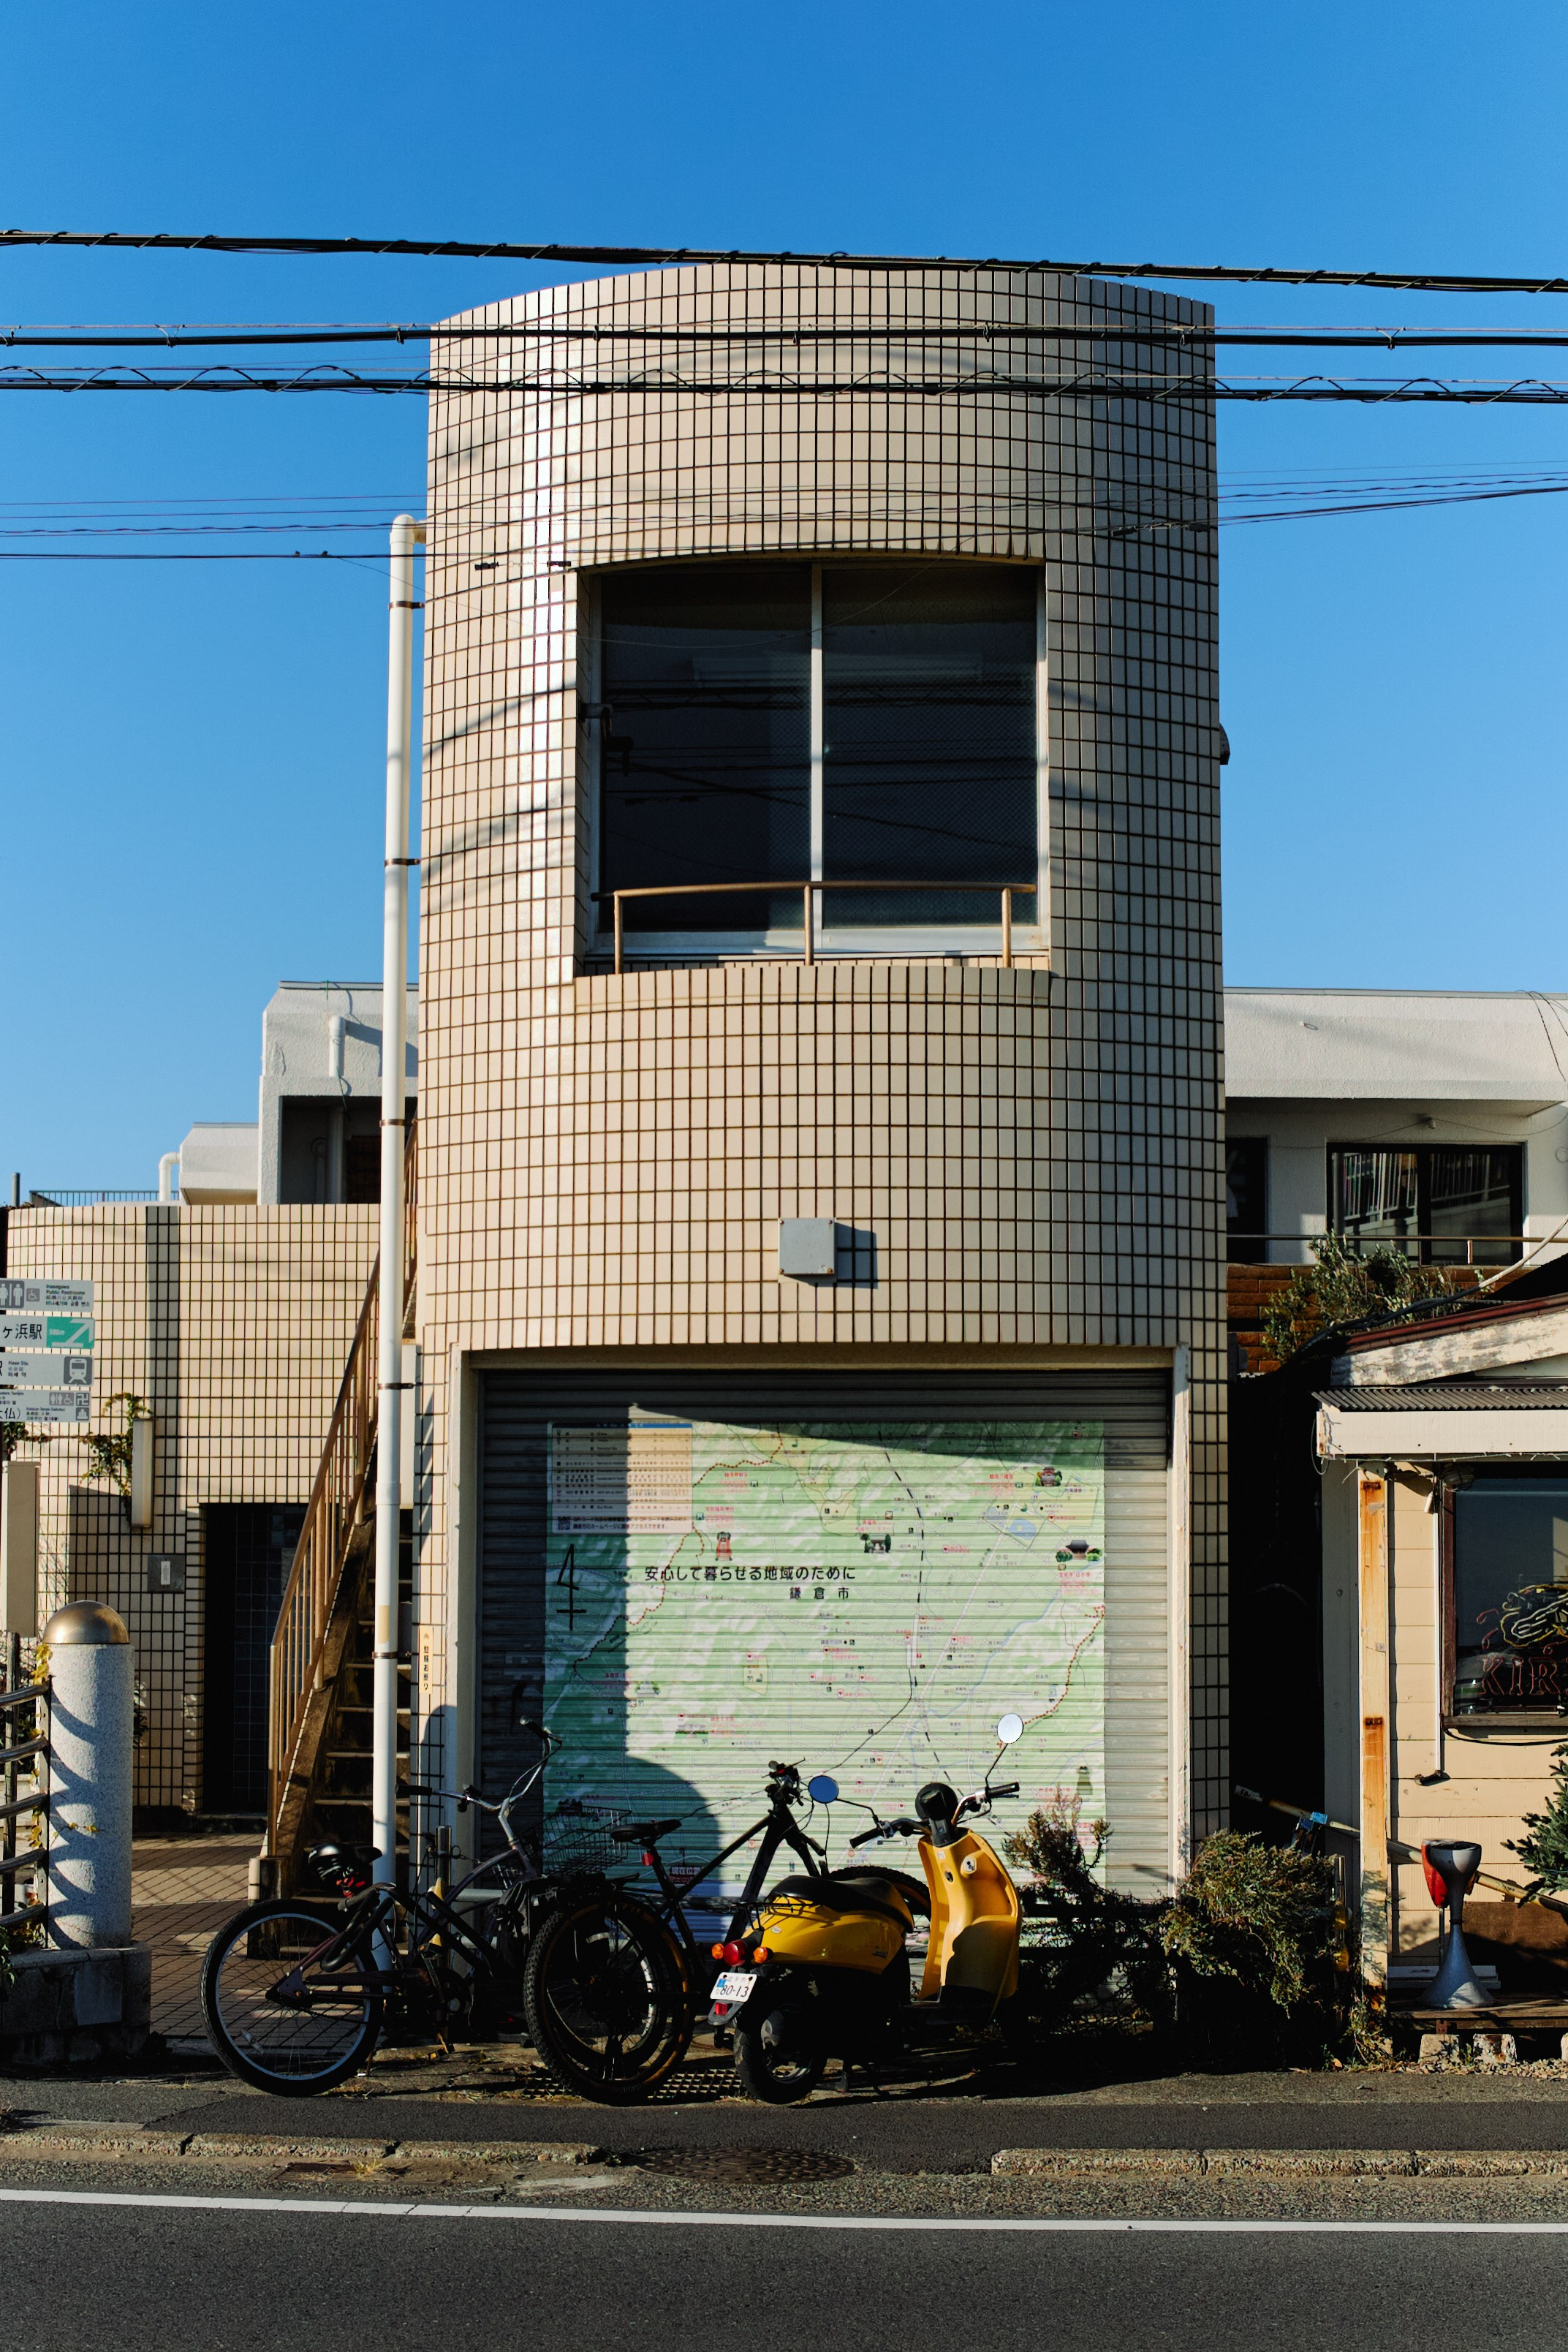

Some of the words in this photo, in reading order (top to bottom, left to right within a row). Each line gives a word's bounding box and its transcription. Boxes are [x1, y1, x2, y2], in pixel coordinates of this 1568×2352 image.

[645, 1566, 855, 1581] 安心して暮らせる地域のために
[790, 1587, 849, 1600] 鎌倉市
[1478, 1656, 1568, 1696] KIR
